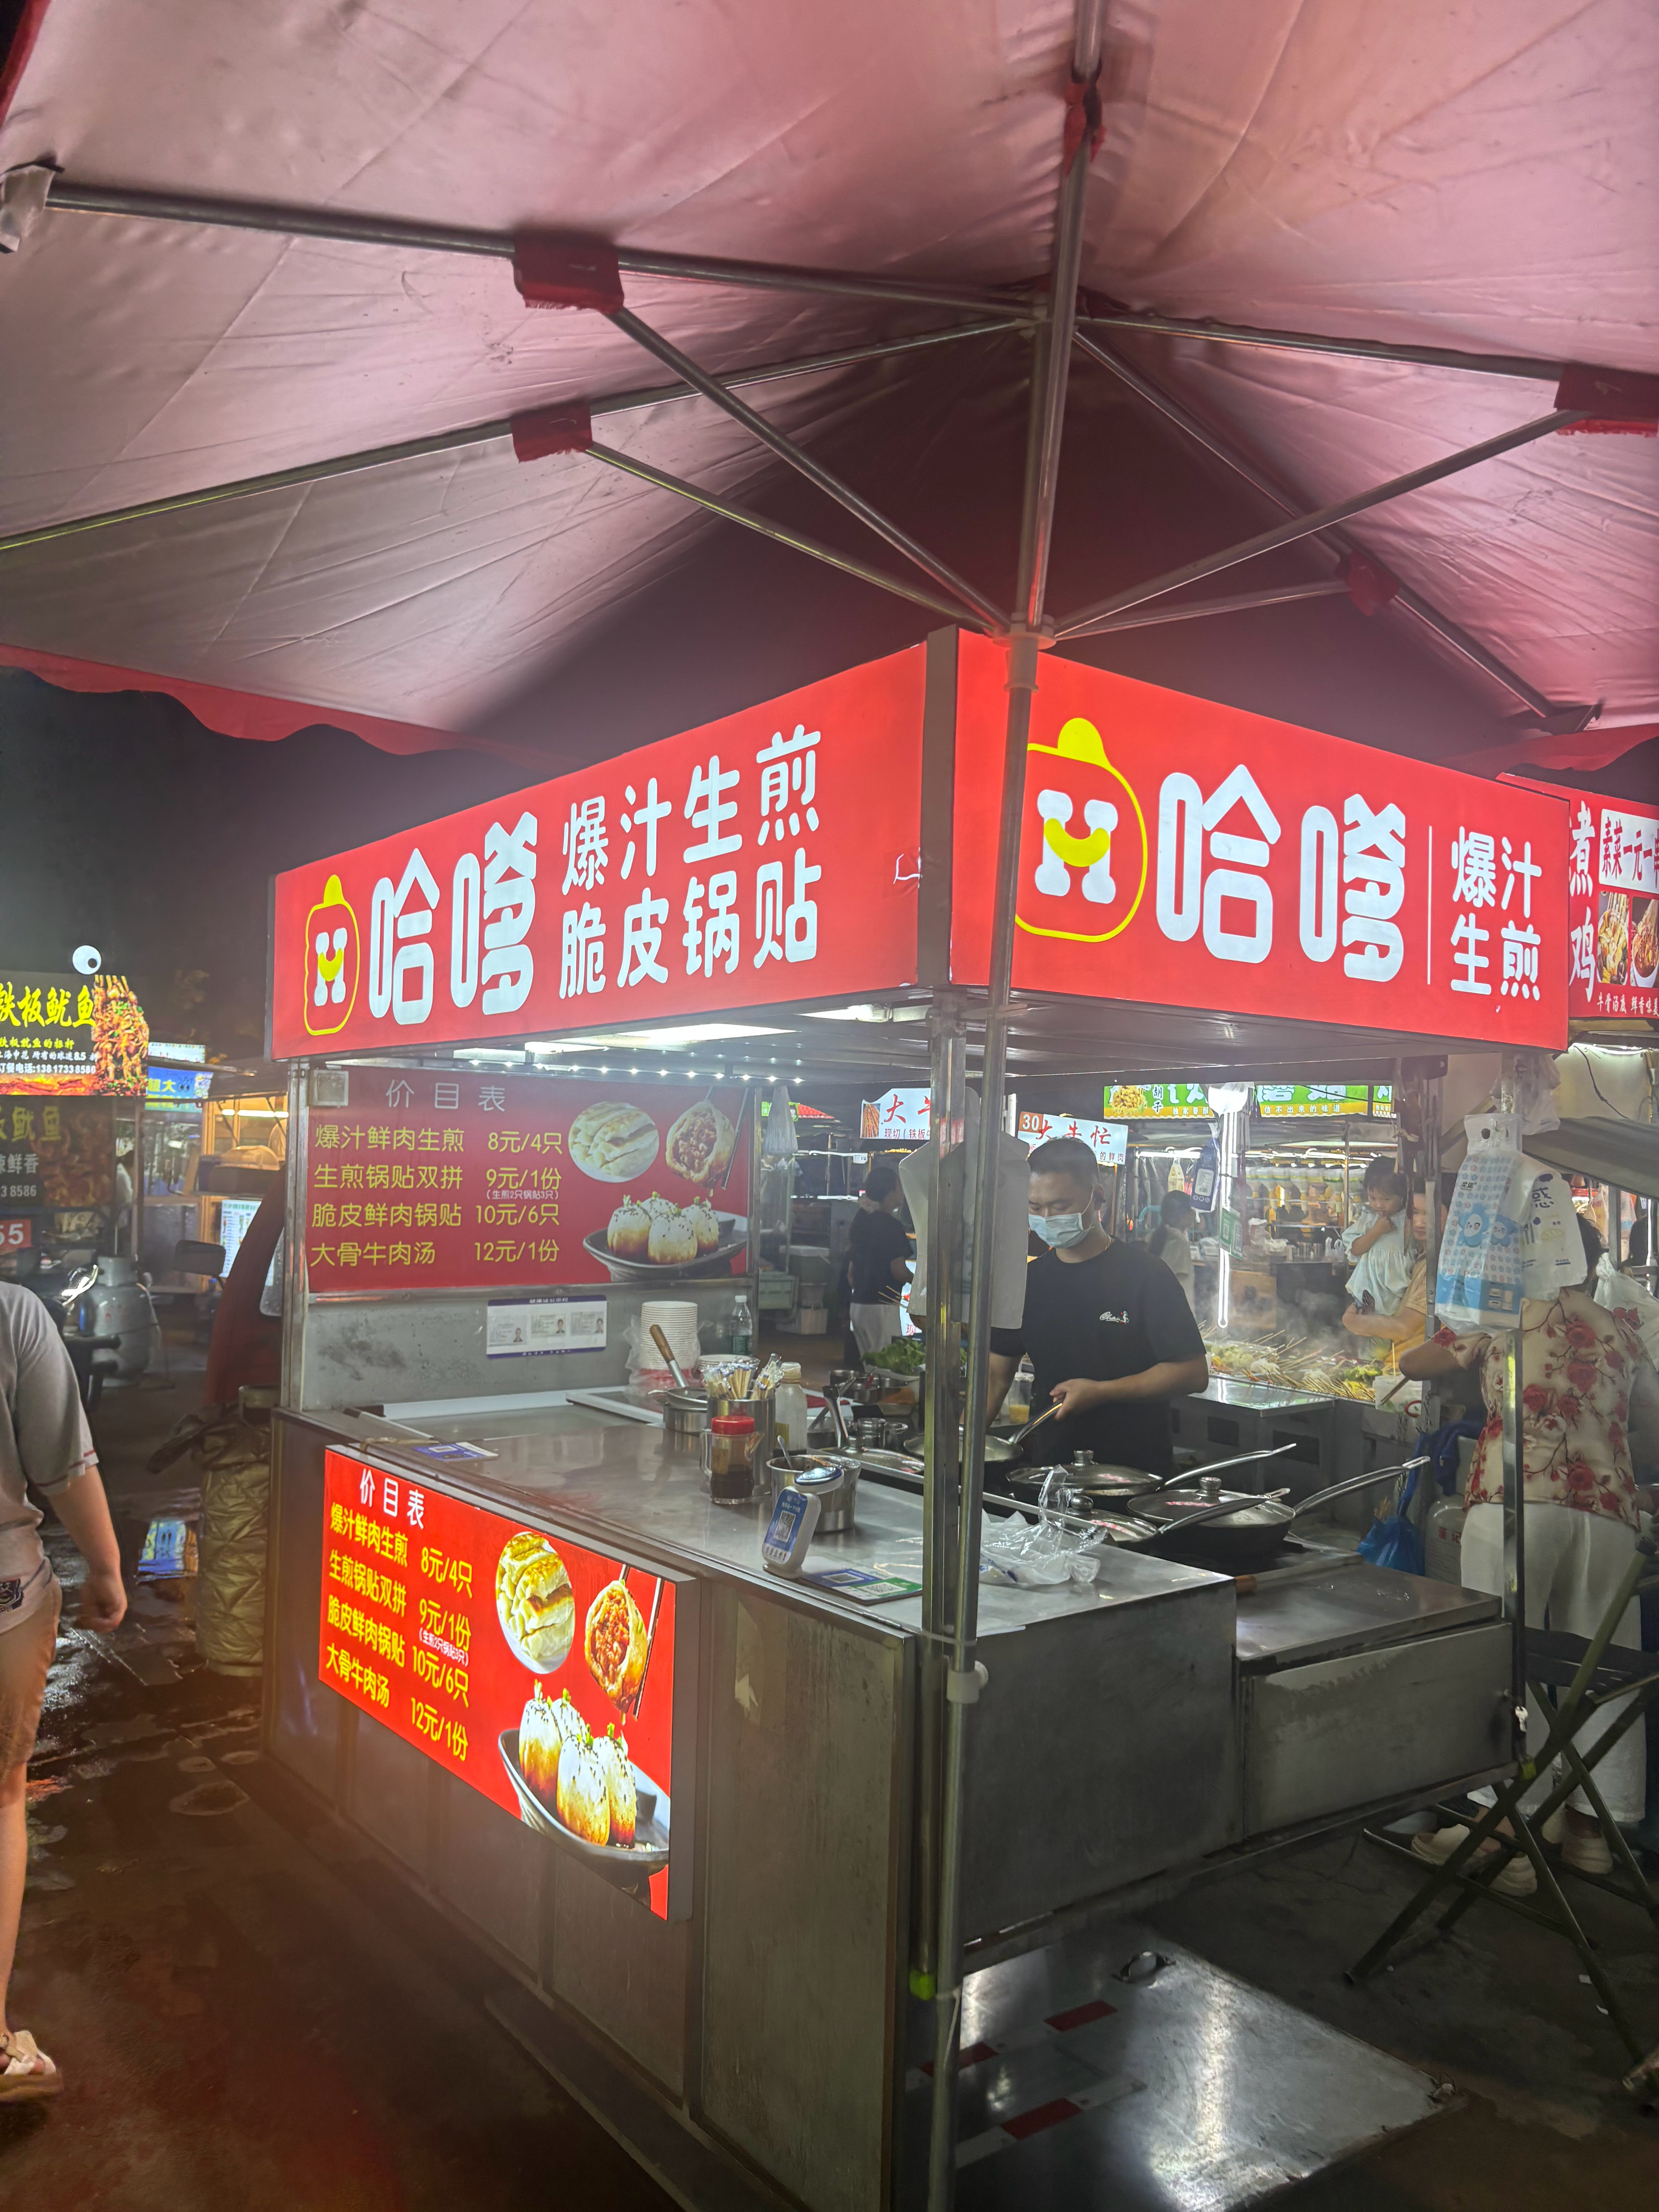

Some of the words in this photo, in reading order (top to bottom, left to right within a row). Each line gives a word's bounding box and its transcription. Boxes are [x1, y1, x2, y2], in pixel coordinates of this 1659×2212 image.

[562, 725, 821, 895] 爆汁生煎
[1451, 826, 1542, 918] 爆汁
[558, 847, 821, 1000] 脆皮锅贴
[1451, 913, 1540, 1001] 生煎
[0, 981, 96, 1027] 铁板鱿鱼
[386, 1080, 505, 1111] 价目表
[1023, 1114, 1039, 1131] 30
[314, 1163, 463, 1190] 生煎锅贴双拼
[486, 1167, 561, 1190] 9元/1份
[315, 1125, 464, 1152] 爆汁鲜肉生煎
[488, 1131, 562, 1154] 8元/4只
[312, 1203, 461, 1228] 脆皮鲜肉锅贴
[476, 1204, 559, 1226] 10元/6只
[311, 1241, 435, 1267] 大骨牛肉汤
[475, 1239, 559, 1262] 12元/1份
[360, 1468, 424, 1529] 价目表
[330, 1502, 408, 1567] 爆汁鲜肉生煎
[421, 1547, 472, 1598] 8元/4只
[329, 1549, 406, 1617] 生煎锅贴双拼
[419, 1599, 471, 1652] 9元/1份
[327, 1595, 405, 1668] 脆皮鲜肉锅贴
[413, 1646, 469, 1708] 10元/6只
[326, 1643, 389, 1708] 大骨牛肉汤
[411, 1698, 468, 1761] 12元/1份
